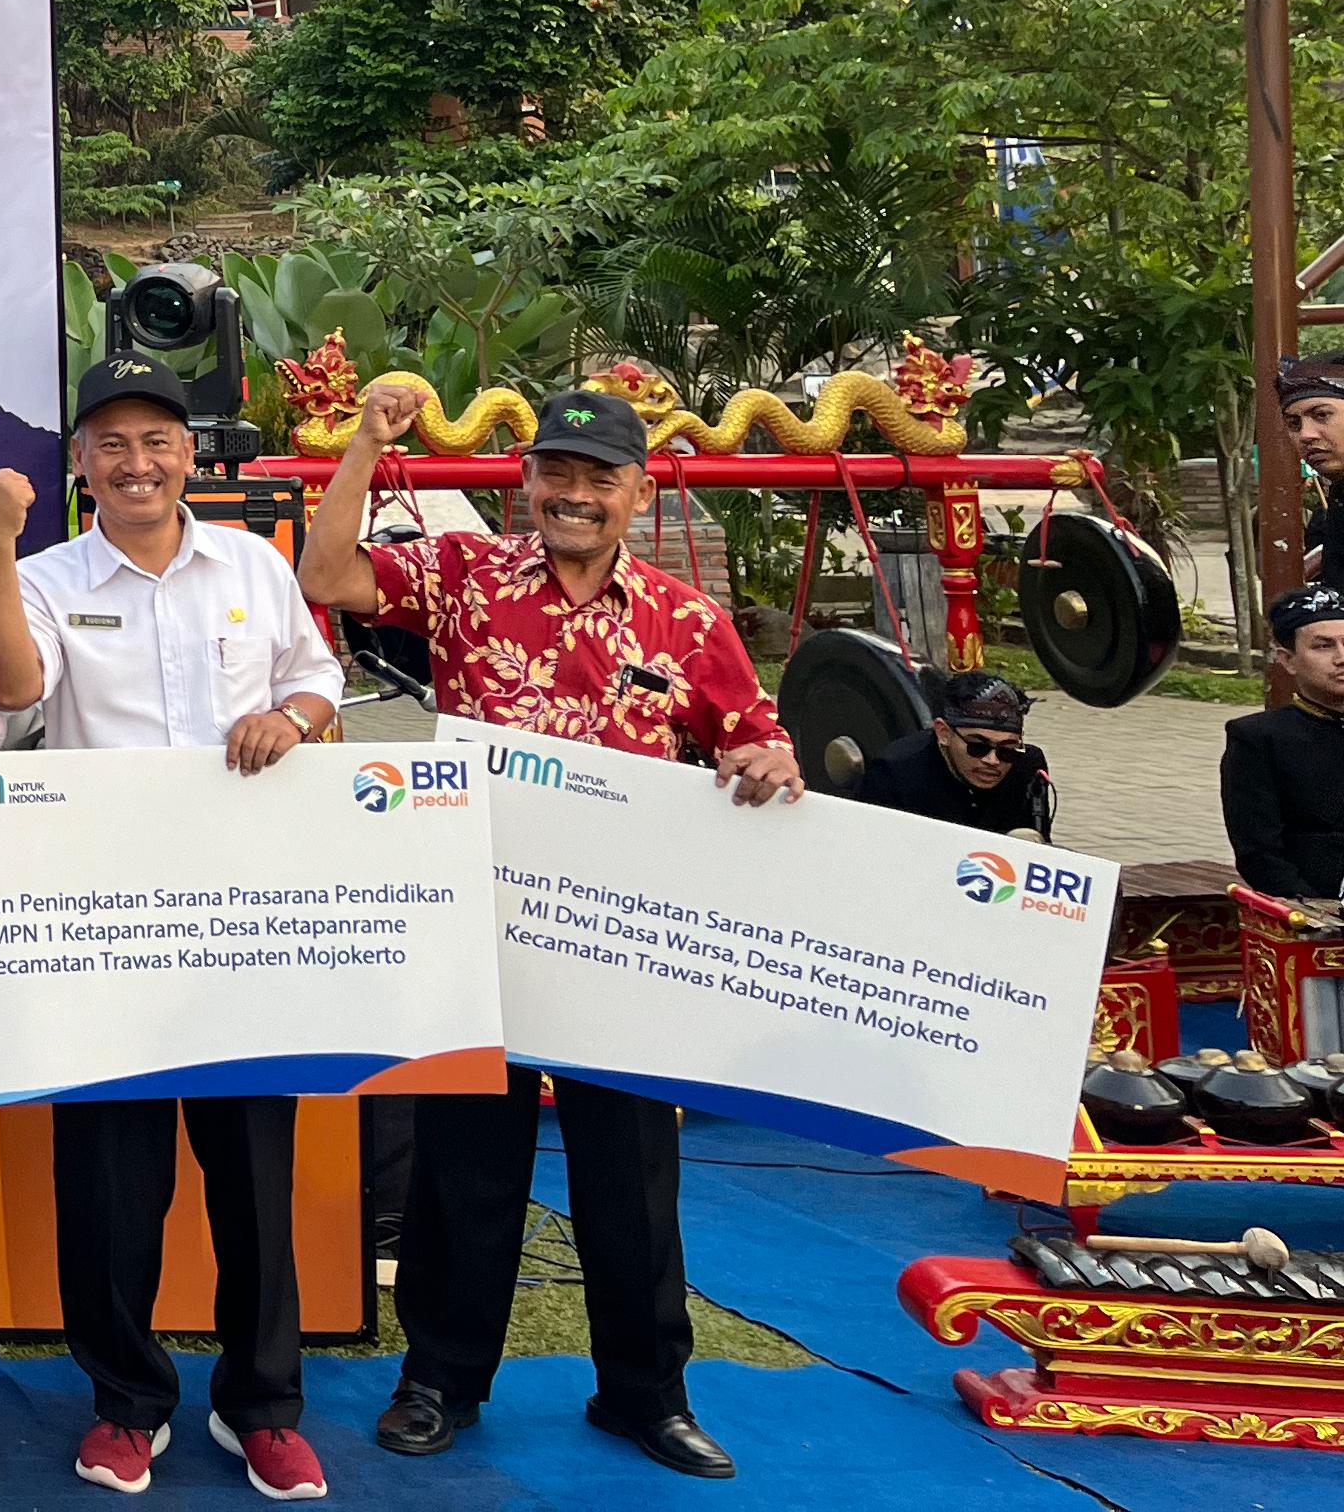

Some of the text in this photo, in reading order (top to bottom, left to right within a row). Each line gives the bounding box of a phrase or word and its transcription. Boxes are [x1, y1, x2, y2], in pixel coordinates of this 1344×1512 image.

[411, 761, 468, 790] BRI
[487, 745, 563, 789] UMN
[566, 771, 608, 788] UNTUK
[8, 781, 45, 792] UNTUK
[8, 792, 67, 804] INDONESIA
[564, 783, 629, 805] INDONESIA
[412, 792, 469, 810] peduli
[1023, 862, 1091, 906] BRI
[20, 889, 148, 915] Peningkatan
[153, 888, 223, 907] Sarana
[228, 886, 328, 905] Prasarana
[335, 882, 454, 903] Pendidikan
[1021, 894, 1088, 922] peduli
[44, 923, 52, 942] 1
[61, 921, 204, 944] Ketapanrame,
[209, 917, 259, 937] Desa
[265, 916, 406, 939] Ketapanrame
[557, 875, 699, 925] Peningkatan
[704, 910, 783, 945] Sarana
[790, 929, 904, 974] Prasarana
[911, 958, 1046, 1010] Pendidikan
[99, 951, 172, 970] Trawas
[177, 947, 291, 972] Kabupaten
[296, 944, 405, 970] Mojokerto
[520, 896, 969, 1021] MI Dwi Dasa Warsa, Desa Ketapanrame
[504, 922, 978, 1053] Kecamatan Trawas Kabupaten Mojokerto
